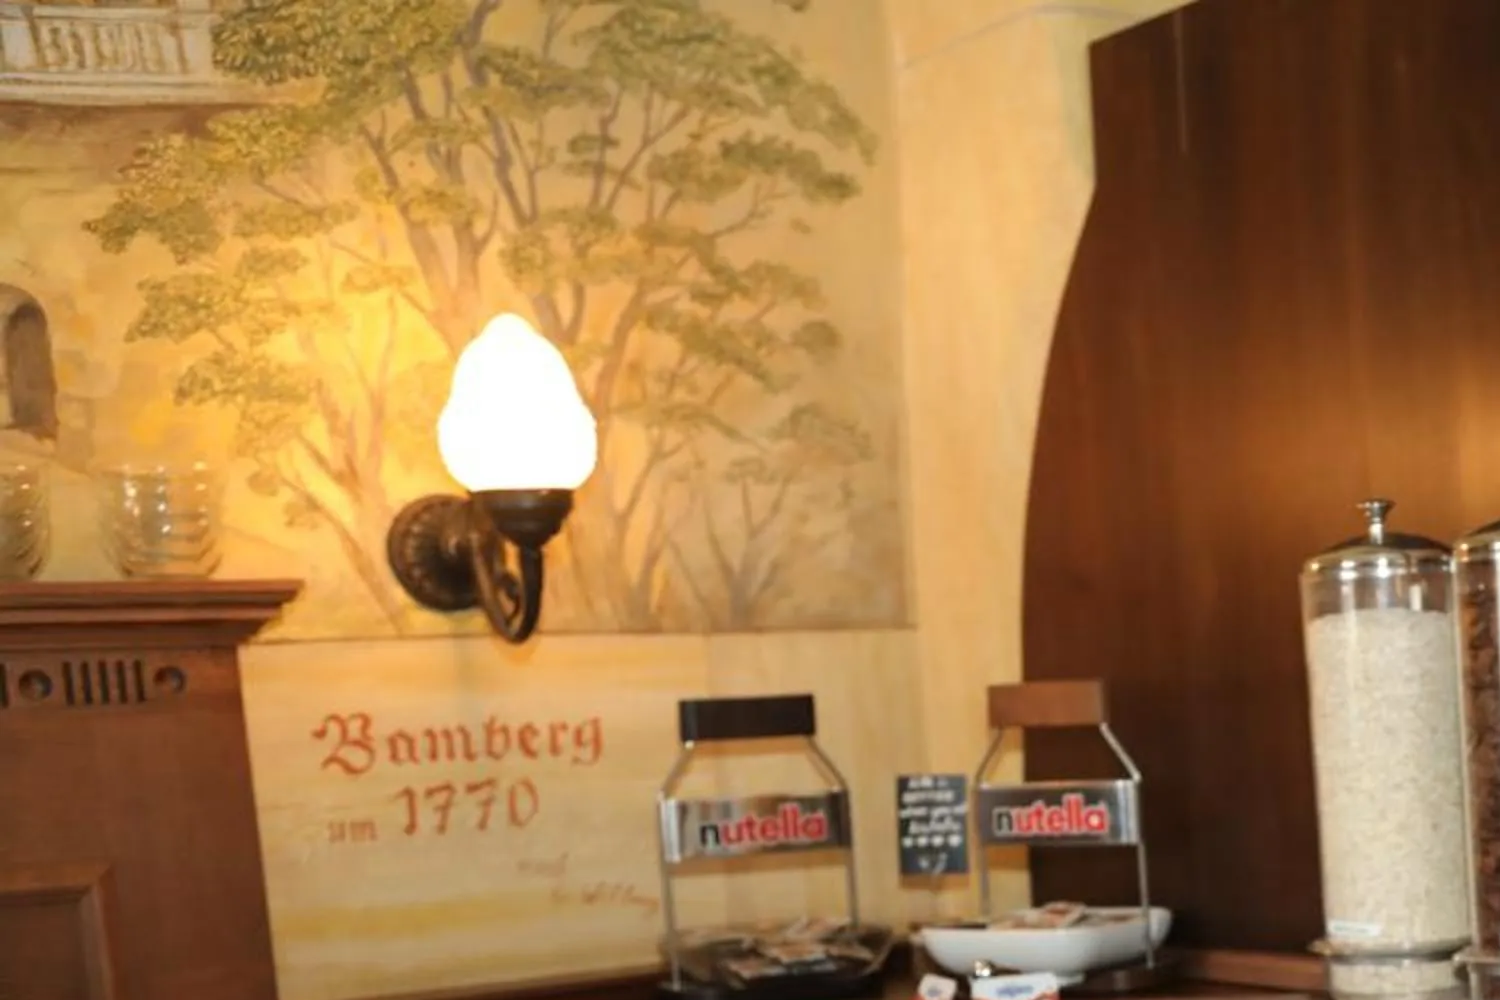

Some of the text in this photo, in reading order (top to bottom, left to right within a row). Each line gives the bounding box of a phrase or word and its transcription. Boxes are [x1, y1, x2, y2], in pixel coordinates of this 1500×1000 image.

[311, 712, 604, 776] Bamberg
[394, 777, 540, 836] 1770
[700, 802, 828, 849] nutella
[994, 793, 1110, 836] nutella
